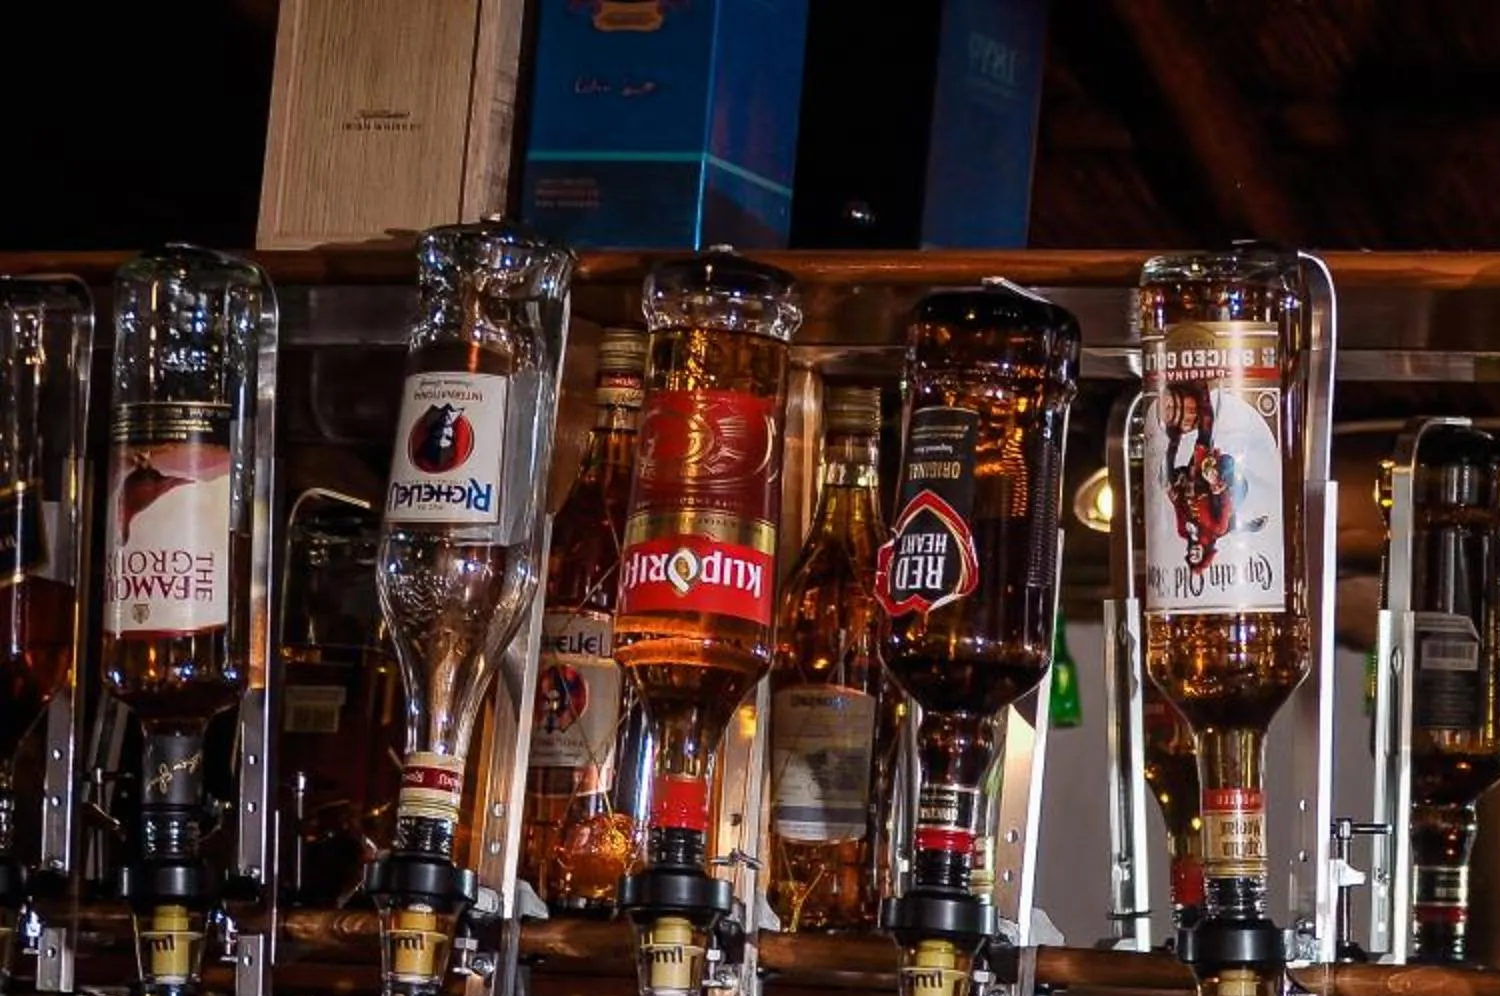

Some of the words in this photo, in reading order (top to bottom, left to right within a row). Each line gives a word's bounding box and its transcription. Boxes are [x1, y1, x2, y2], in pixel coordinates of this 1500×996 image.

[1181, 348, 1255, 369] SICED
[1158, 369, 1225, 381] ORIGINA
[899, 533, 948, 554] HEART
[106, 550, 193, 575] GROUS
[895, 555, 946, 591] RED
[1209, 554, 1273, 593] Capain
[103, 576, 193, 602] FAMOU
[195, 553, 214, 602] THE
